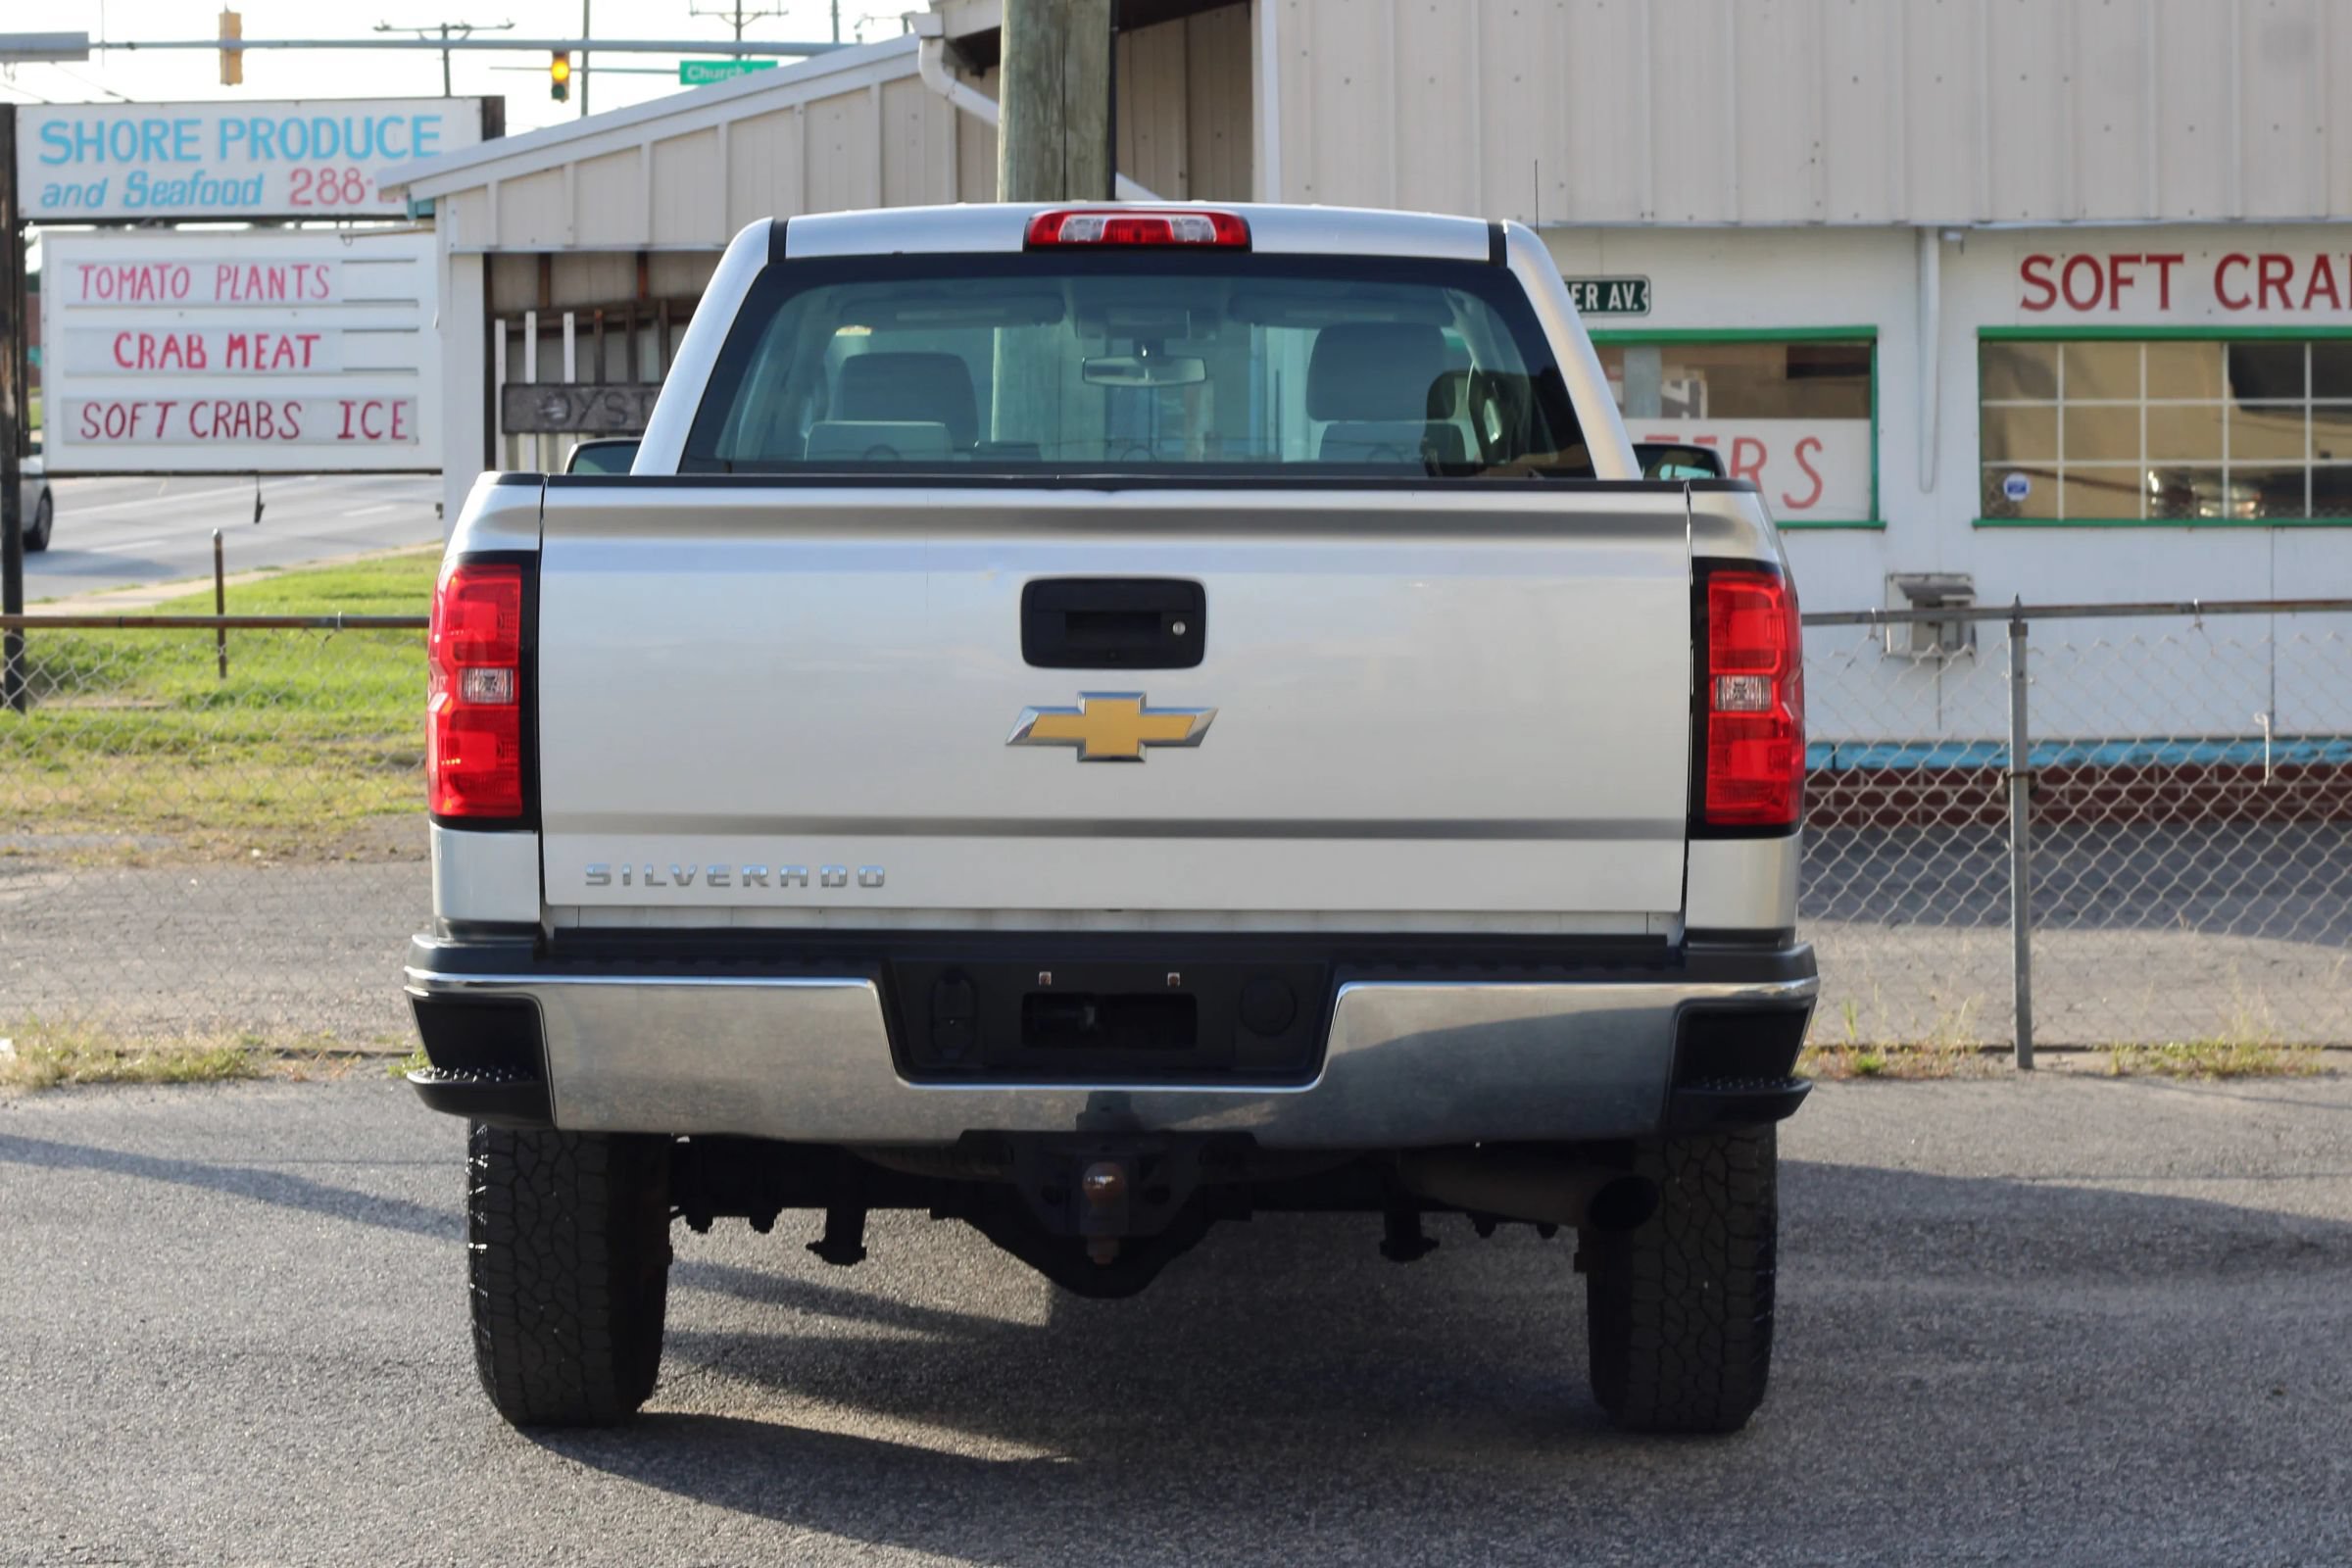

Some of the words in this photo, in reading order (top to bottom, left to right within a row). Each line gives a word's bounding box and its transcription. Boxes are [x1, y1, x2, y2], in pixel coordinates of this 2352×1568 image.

[38, 119, 202, 165] SHORE
[219, 115, 443, 161] PRODUCE
[40, 176, 109, 209] and
[123, 170, 265, 208] Seafood
[78, 264, 190, 302] TOMATO
[215, 264, 330, 302] PLANTS
[1564, 282, 1598, 311] ER
[1607, 282, 1640, 311] AV.
[2020, 253, 2184, 312] SOFT
[2214, 252, 2352, 311] CRA
[113, 331, 207, 369] CRAB
[225, 332, 320, 369] MEAT
[80, 400, 178, 440] SOFT
[188, 400, 303, 440] CRABS
[337, 401, 408, 440] ICE
[584, 863, 886, 888] SILVERADO
